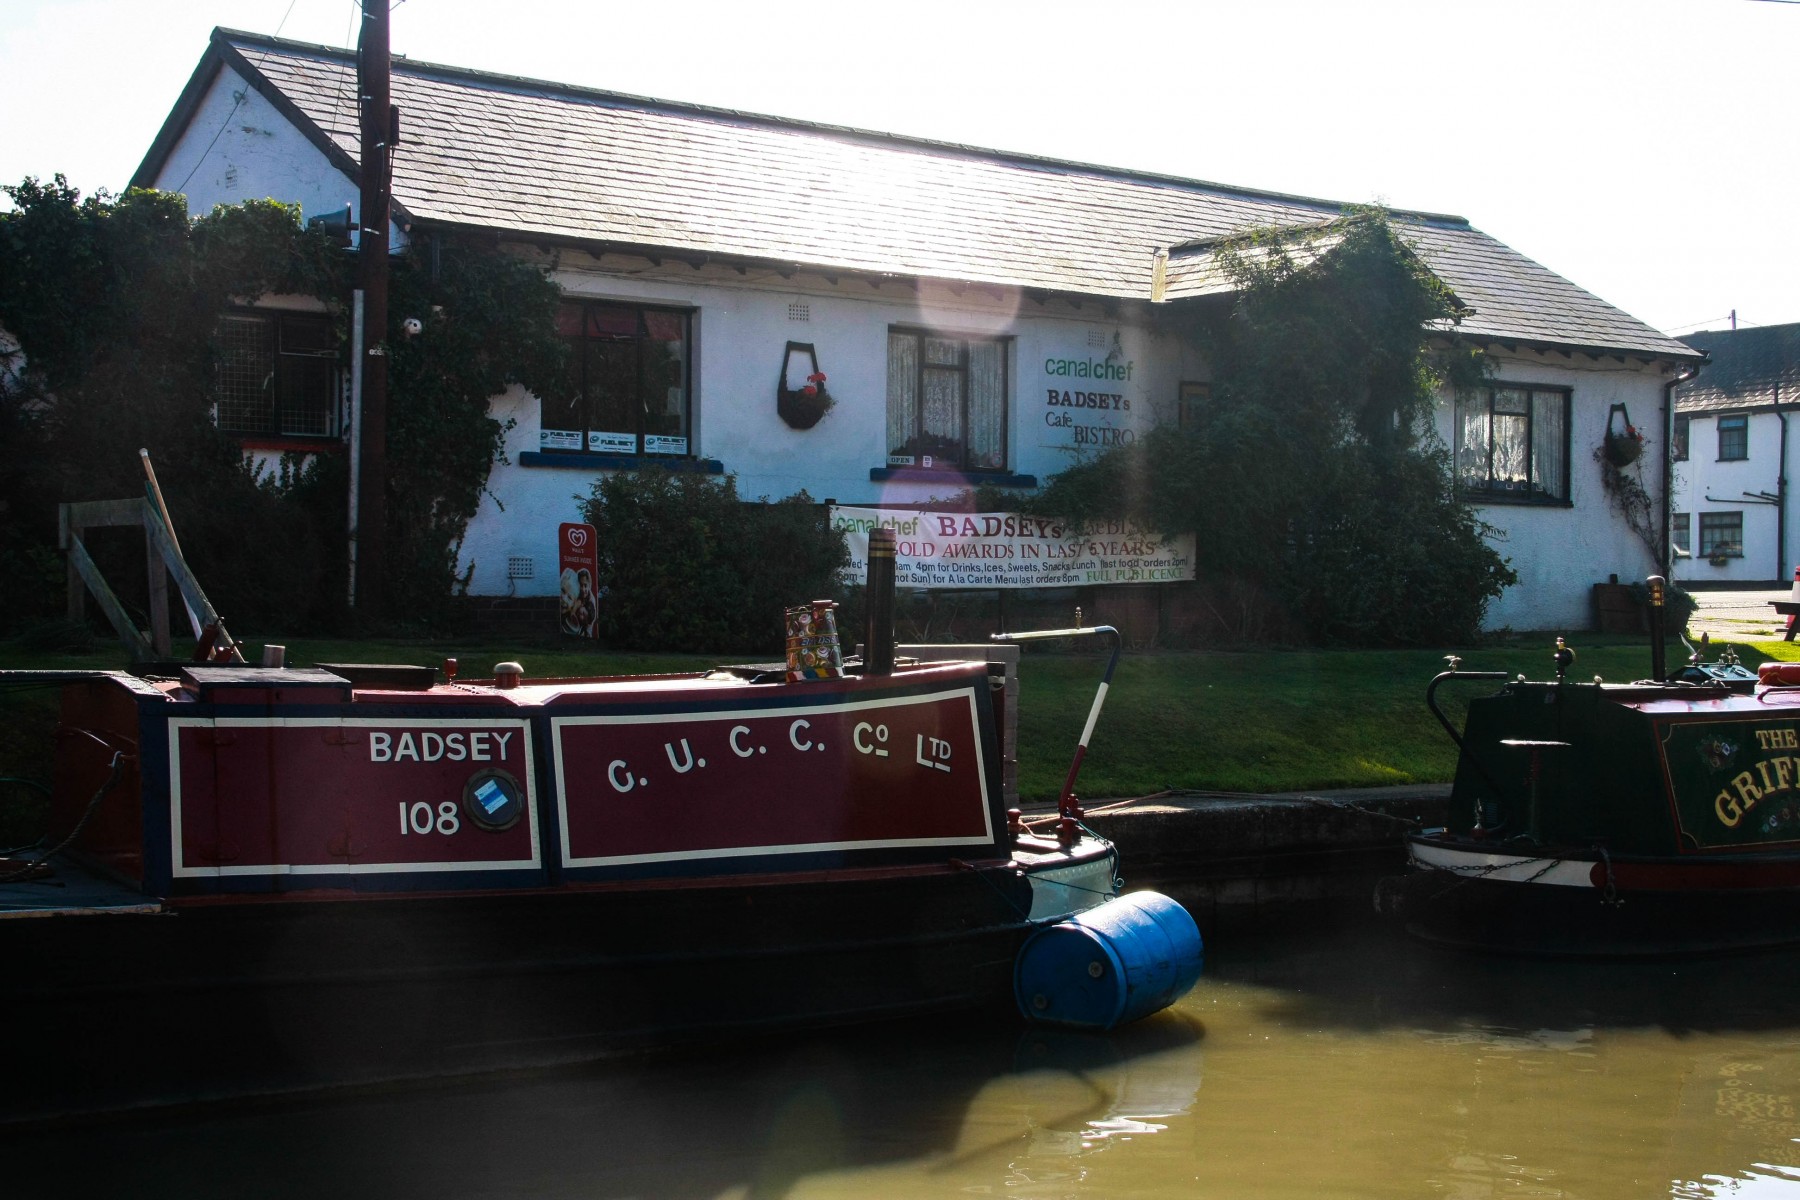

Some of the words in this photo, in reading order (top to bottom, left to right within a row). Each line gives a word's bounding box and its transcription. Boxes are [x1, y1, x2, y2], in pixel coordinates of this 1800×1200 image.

[1045, 357, 1133, 381] canalchef
[1047, 389, 1130, 411] BADSEYs
[1045, 411, 1072, 428] Cafe
[1074, 425, 1135, 446] BISTRO
[942, 543, 1014, 559] AWARDS
[1020, 543, 1040, 559] IN
[1047, 543, 1084, 559] LAST
[1099, 541, 1155, 556] YEARS
[915, 561, 936, 573] 4pm
[938, 562, 950, 572] for
[1072, 559, 1096, 570] Lunch
[1144, 557, 1171, 567] orders
[1086, 569, 1112, 582] FULL
[911, 572, 931, 584] Sun)
[933, 573, 945, 583] for
[948, 574, 956, 583] A
[957, 574, 965, 584] la
[967, 574, 993, 584] Carte
[995, 574, 1018, 584] Menu
[1019, 574, 1034, 584] last
[1035, 574, 1061, 584] orders
[369, 731, 513, 762] BADSEY
[1755, 728, 1798, 750] THE
[399, 801, 460, 835] 108
